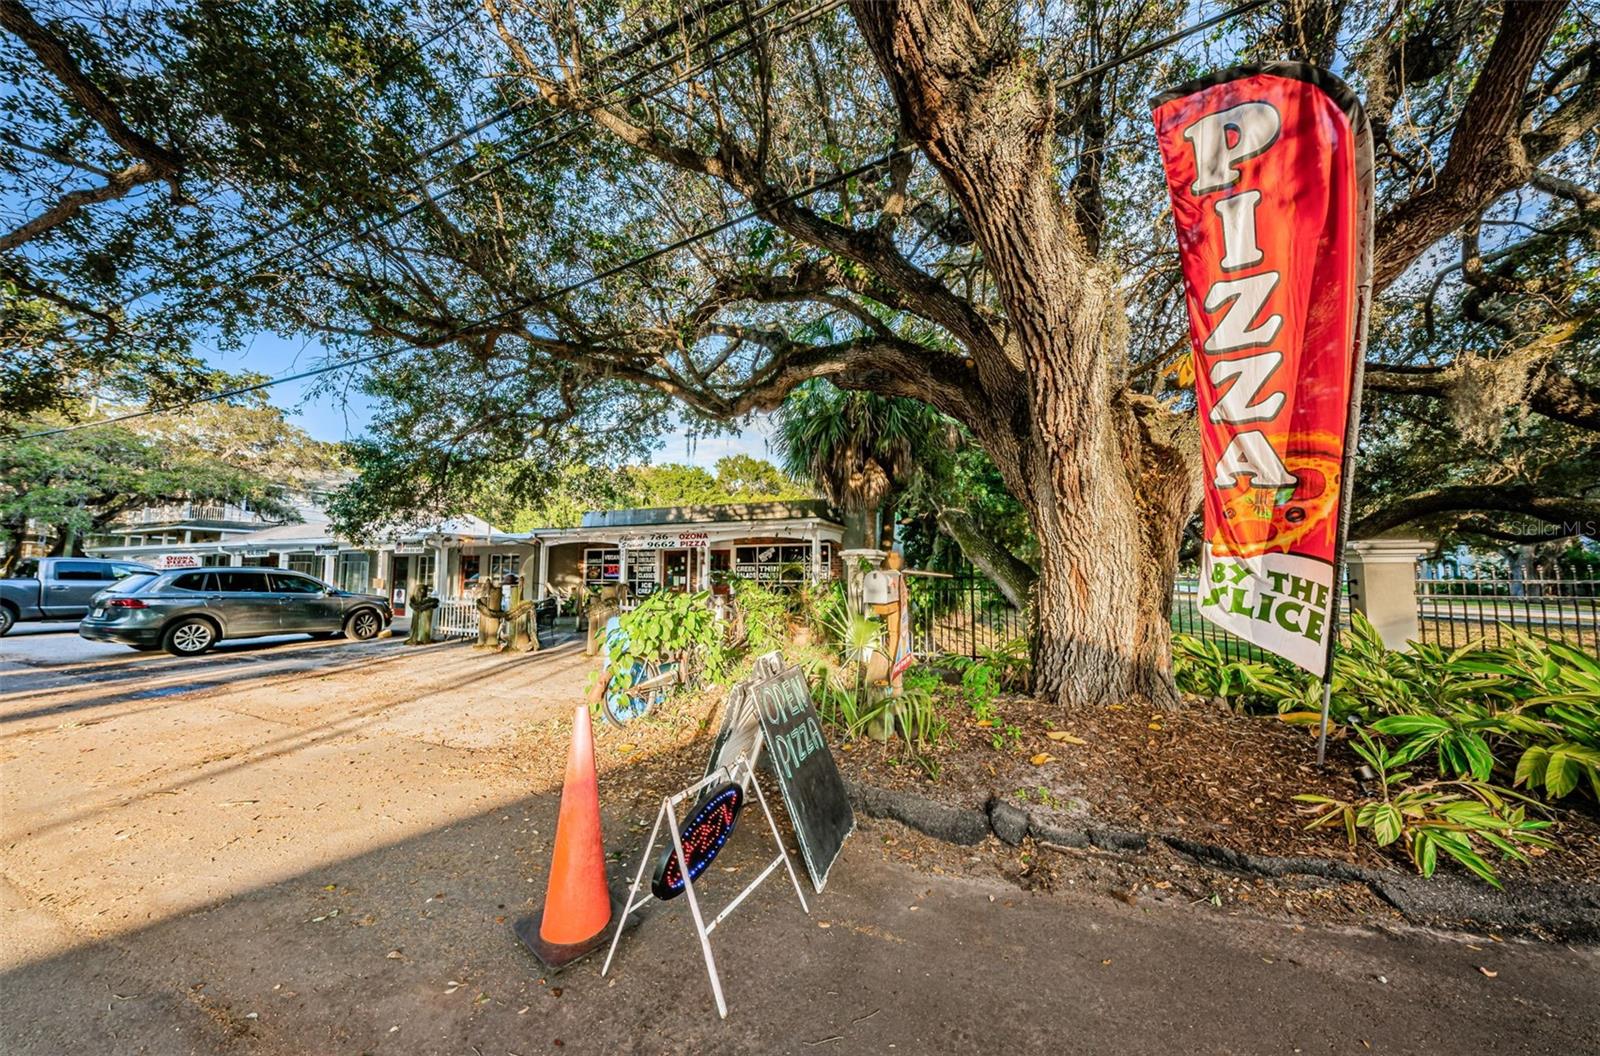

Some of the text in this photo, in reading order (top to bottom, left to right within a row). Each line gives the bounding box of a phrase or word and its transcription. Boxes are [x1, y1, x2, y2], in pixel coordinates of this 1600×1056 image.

[1183, 101, 1298, 490] PIZZA
[679, 532, 709, 540] OZONA
[680, 540, 707, 548] PIZZA
[1212, 562, 1330, 612] BY THE
[1202, 585, 1326, 646] SLICE
[762, 675, 809, 725] OPEN
[774, 717, 824, 779] PIZZA
